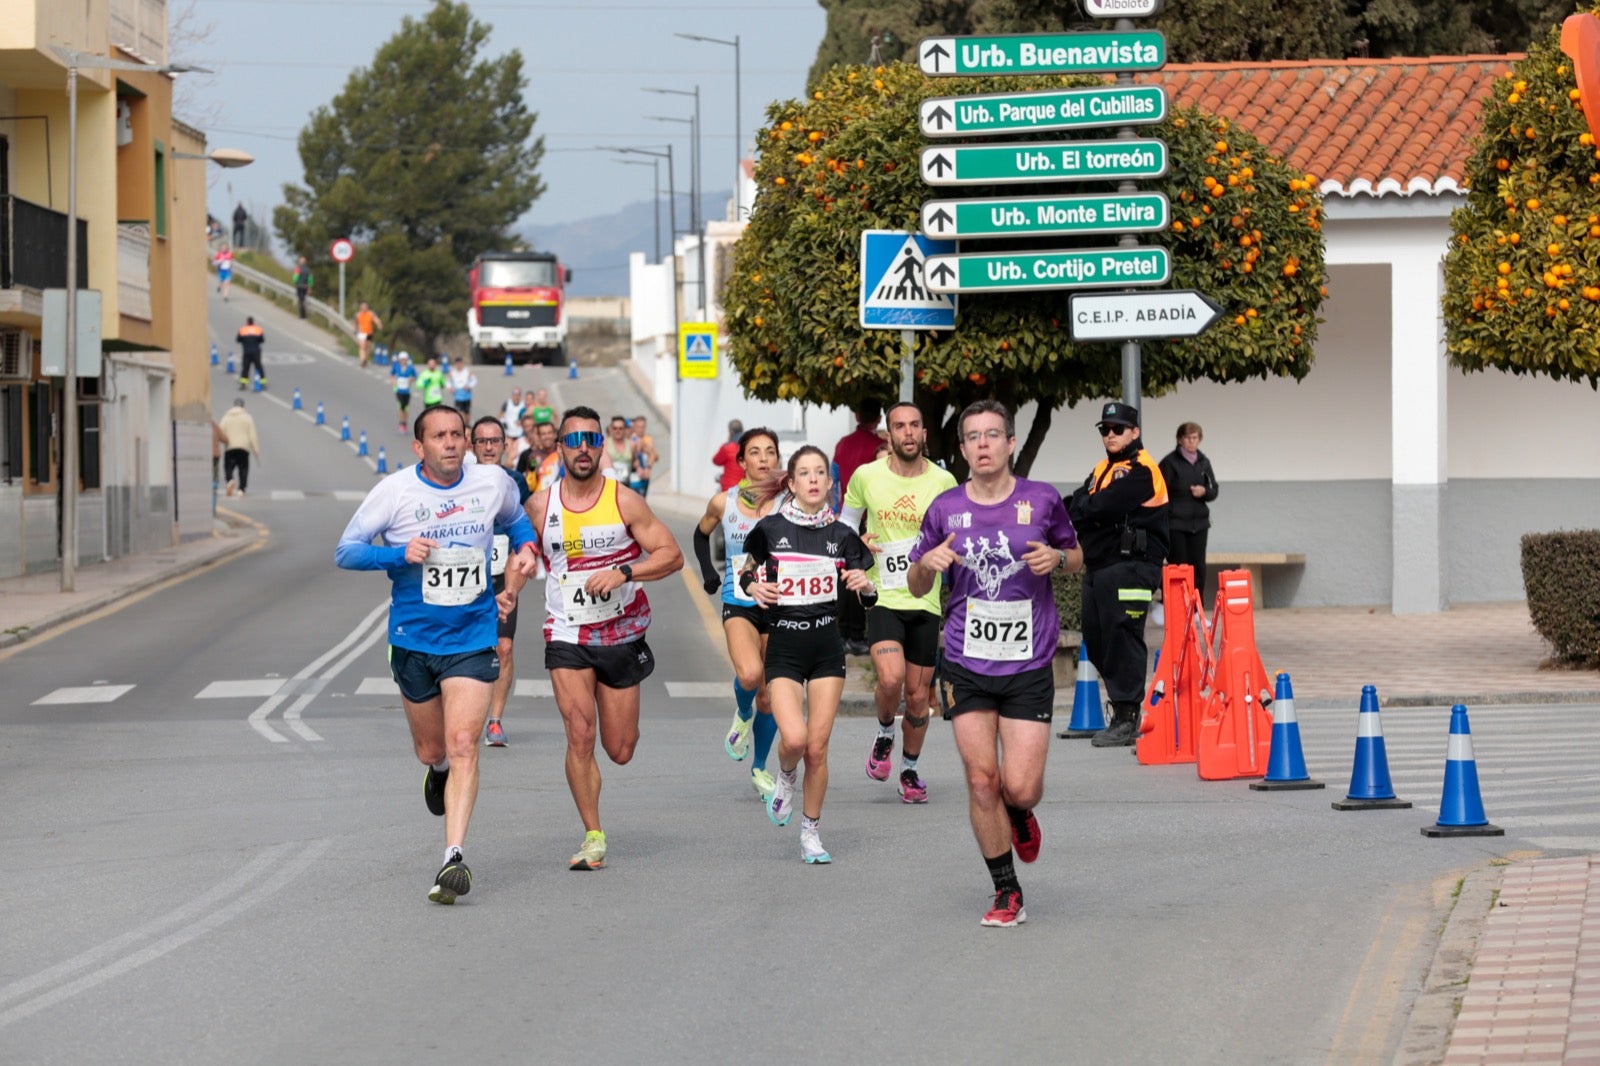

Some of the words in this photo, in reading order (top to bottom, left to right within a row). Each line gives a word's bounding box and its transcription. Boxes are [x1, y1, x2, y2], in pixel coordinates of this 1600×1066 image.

[961, 44, 1013, 68] Urb.
[1020, 41, 1158, 66] Buenavista
[960, 105, 994, 124] Urb.
[999, 103, 1056, 123] Parque
[1060, 98, 1085, 118] del
[1090, 95, 1154, 116] Cubillas
[1016, 152, 1056, 171] Urb.
[1062, 151, 1080, 169] El
[1086, 149, 1155, 168] torreón
[991, 208, 1031, 226] Urb.
[1037, 206, 1097, 224] Monte
[1103, 203, 1155, 222] Elvira
[987, 262, 1027, 280] Urb.
[1033, 258, 1096, 281] Cortijo
[1102, 256, 1157, 276] Pretel
[1077, 310, 1129, 324] C.E.I.P.
[1136, 304, 1197, 322] ABADÍA
[419, 523, 485, 539] MARACENA
[427, 565, 480, 588] 3171
[781, 575, 834, 596] 2183
[776, 619, 810, 630] PRO
[970, 618, 1028, 642] 3072
